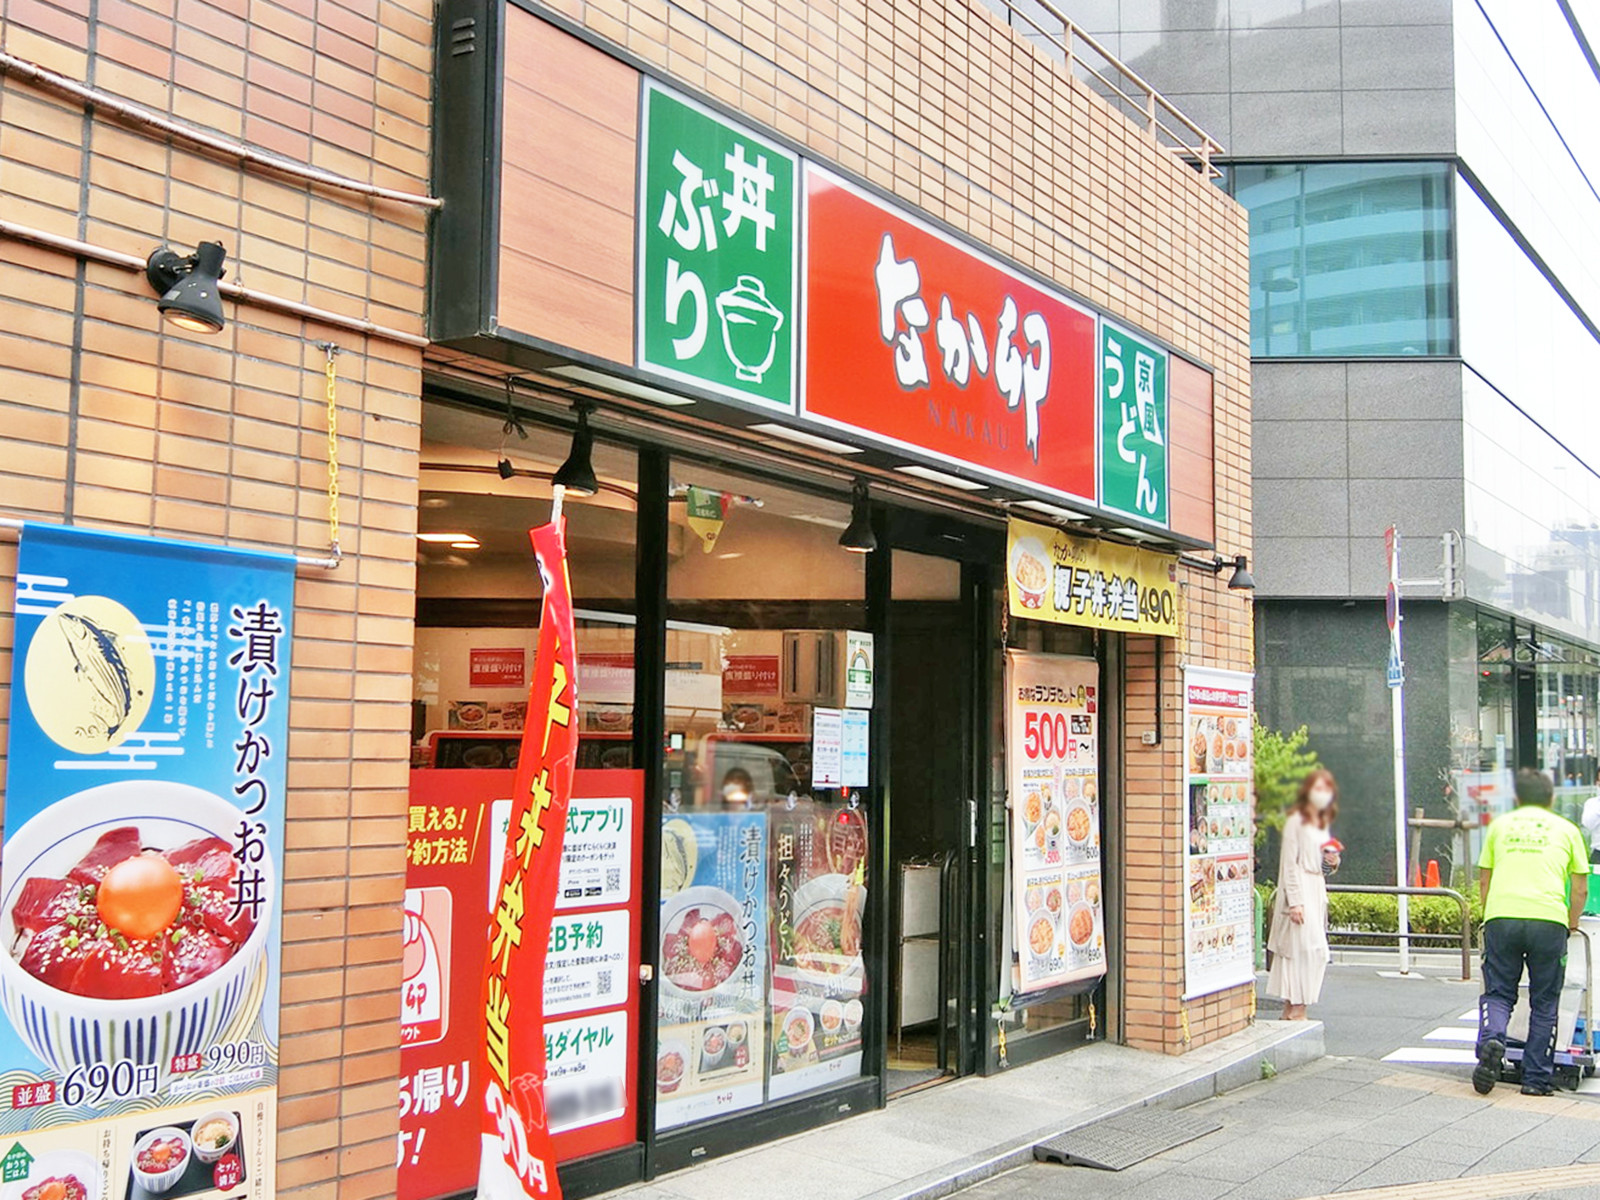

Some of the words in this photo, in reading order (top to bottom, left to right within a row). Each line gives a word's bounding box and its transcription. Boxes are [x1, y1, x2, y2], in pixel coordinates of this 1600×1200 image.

[875, 231, 1051, 466] なか卯
[927, 398, 1009, 451] NAKAU
[1104, 336, 1158, 515] うどん
[1140, 587, 1173, 625] 490
[229, 602, 282, 922] 漬けかつお丼
[174, 1055, 198, 1072] 特盛
[209, 1041, 265, 1072] 990円
[17, 1084, 52, 1106] 並盛
[62, 1061, 158, 1106] 690円
